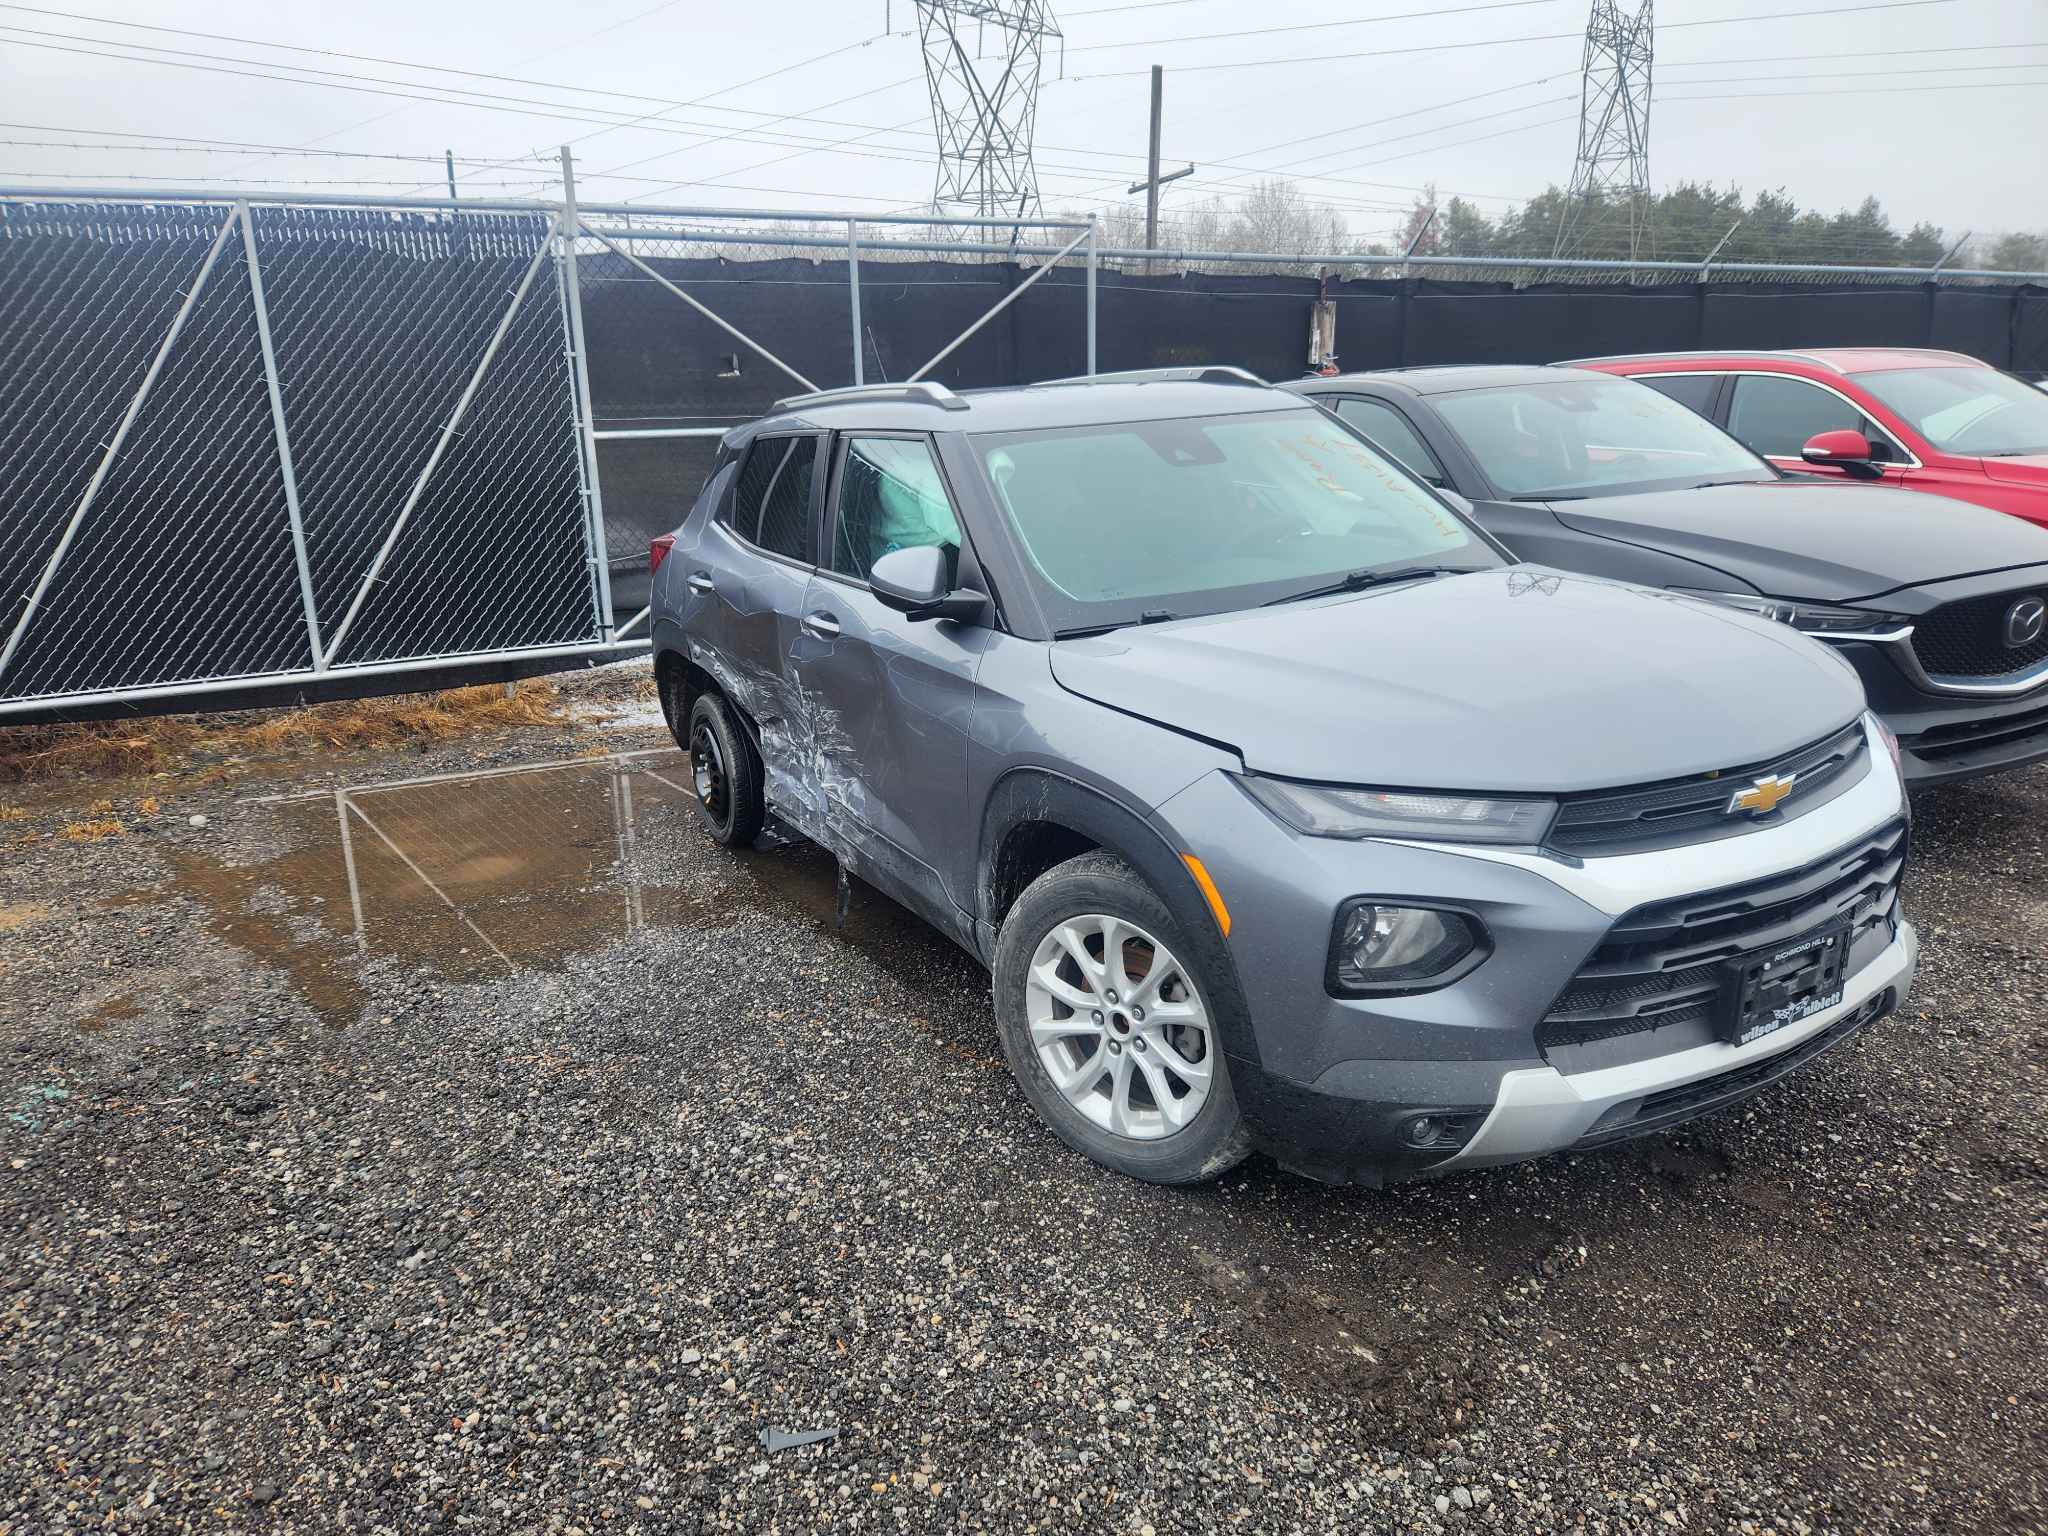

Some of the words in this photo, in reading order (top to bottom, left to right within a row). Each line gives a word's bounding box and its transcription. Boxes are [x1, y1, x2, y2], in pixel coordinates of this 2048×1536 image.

[1775, 943, 1811, 961] RICHMOND
[1812, 937, 1826, 947] HILL
[1741, 1020, 1779, 1043] wilson
[1803, 992, 1841, 1016] niblett
